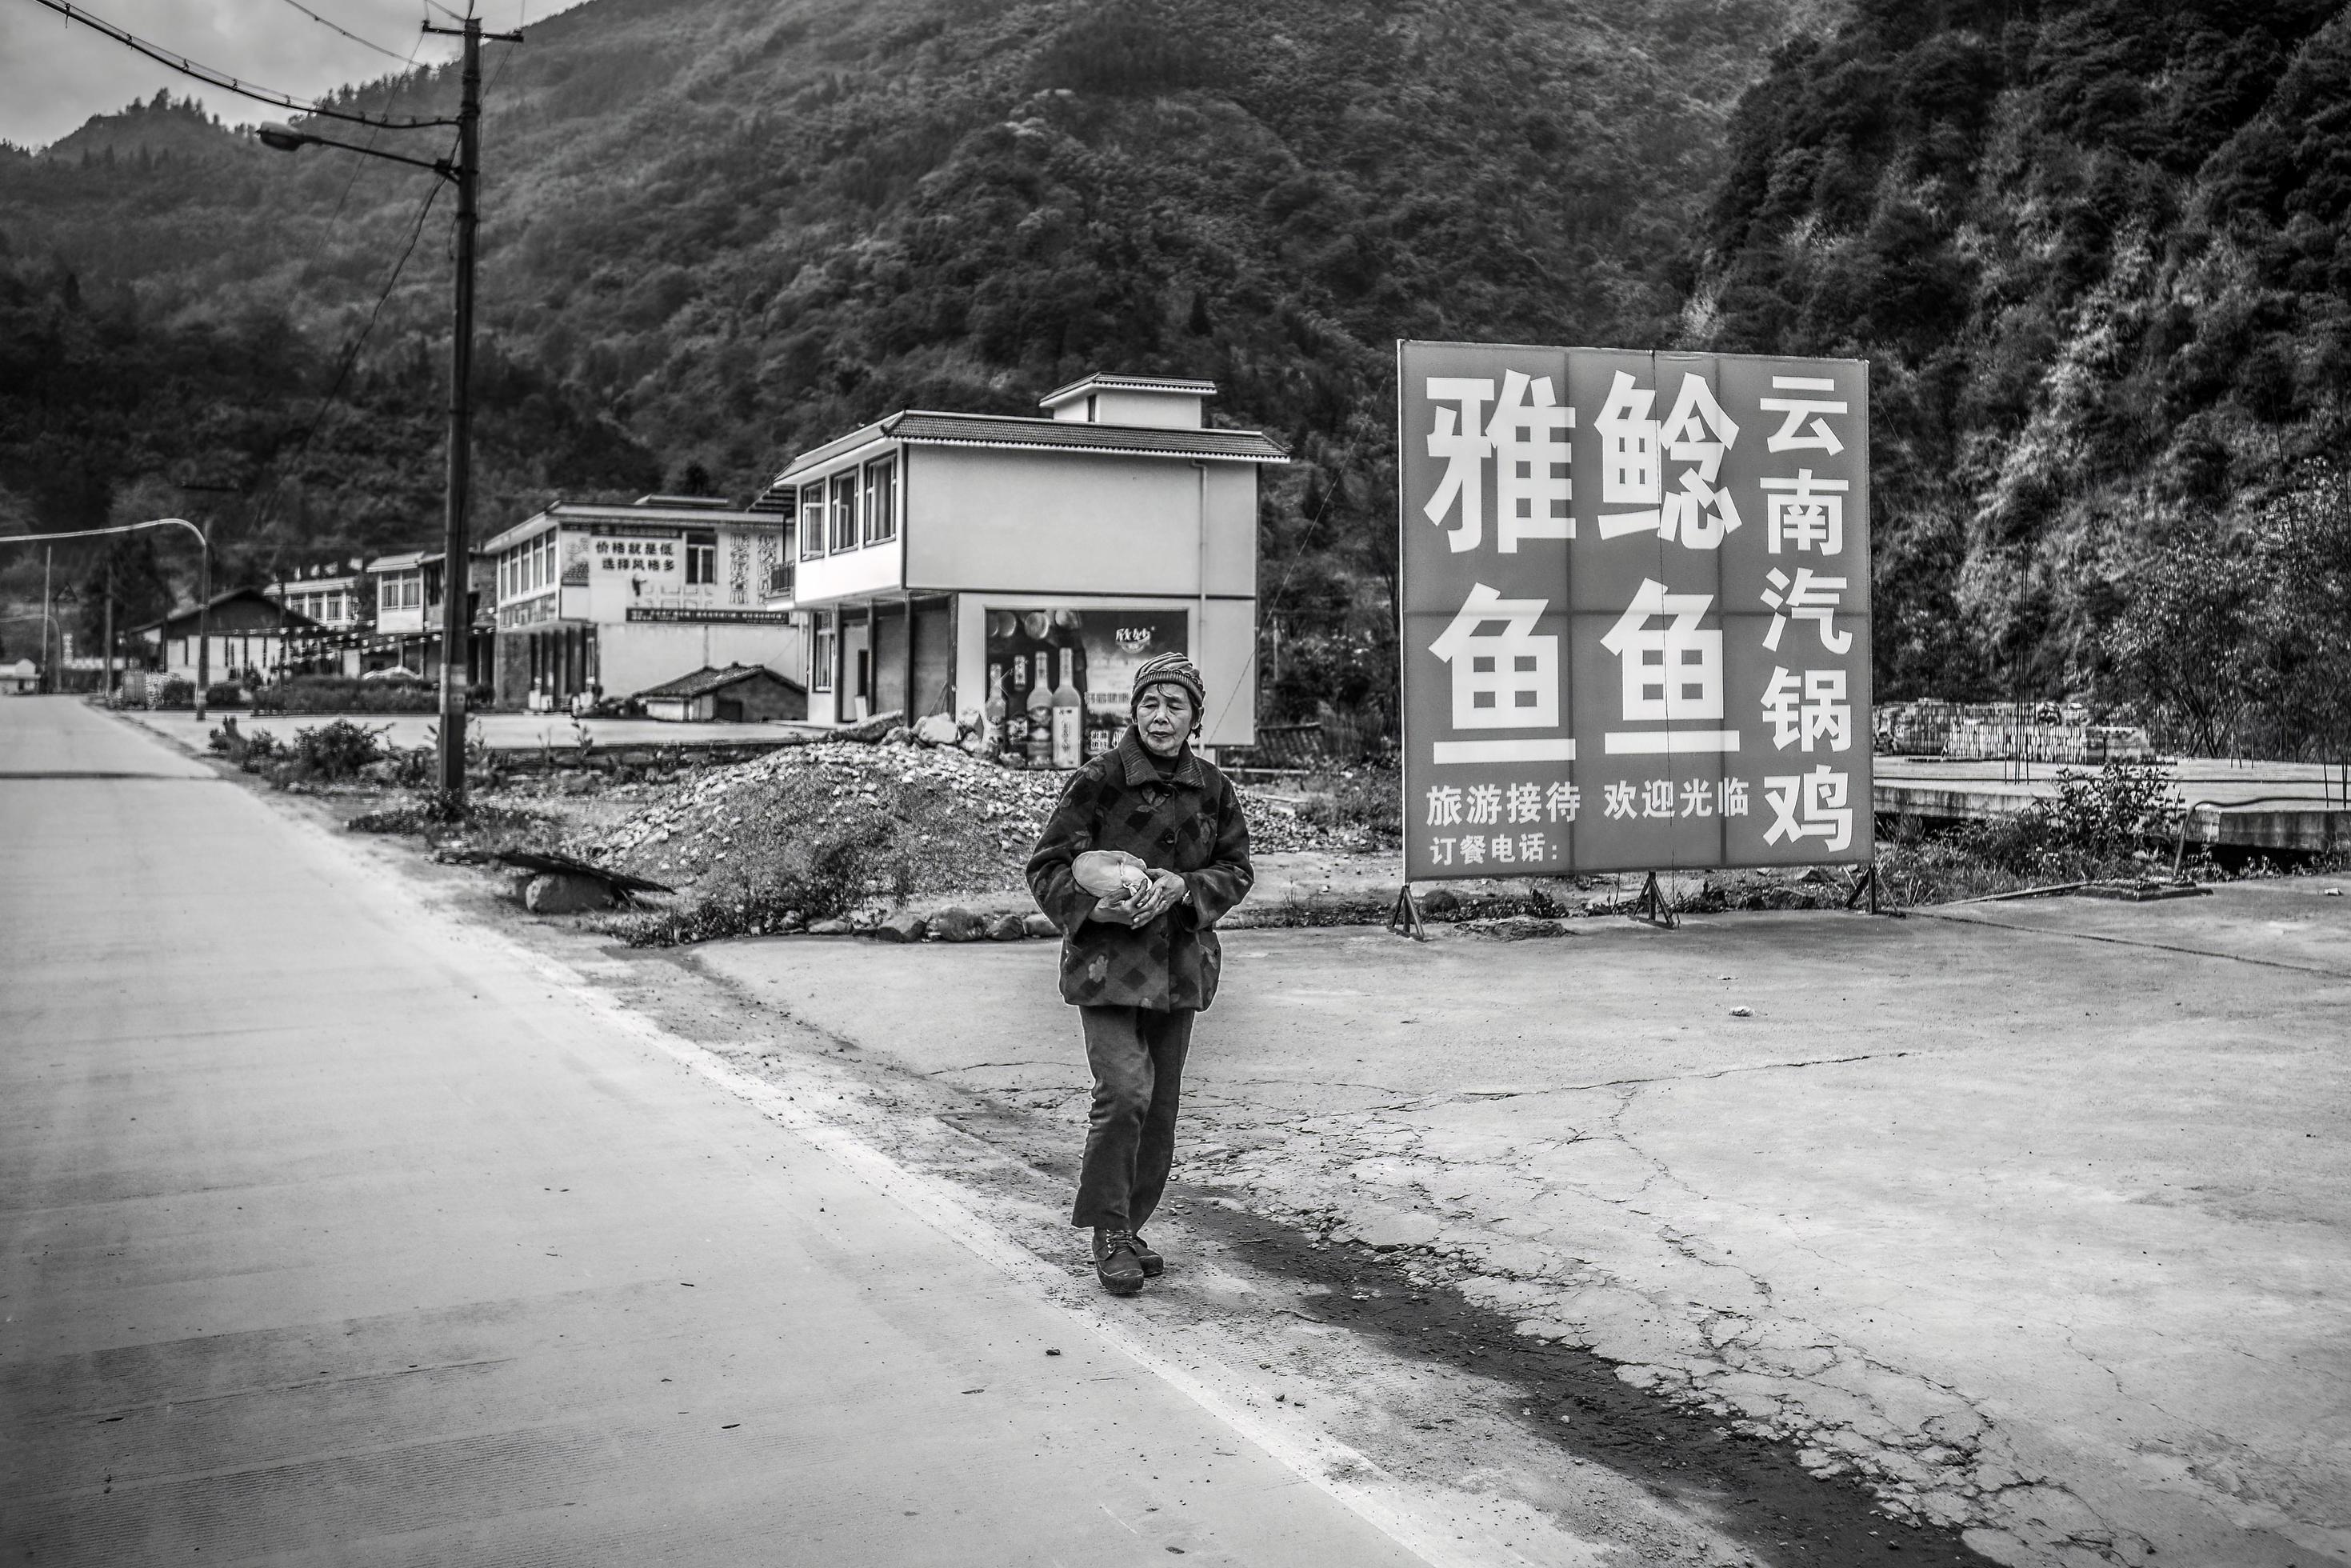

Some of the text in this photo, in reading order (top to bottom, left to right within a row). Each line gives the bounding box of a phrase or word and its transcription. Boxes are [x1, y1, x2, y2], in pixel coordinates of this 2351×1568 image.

[1423, 368, 1577, 765] 雅鱼
[1593, 369, 1742, 755] 鲶鱼
[1759, 374, 1853, 853] 云南汽锅鸡
[1425, 777, 1749, 826] 旅游接待 欢迎光临
[1429, 832, 1557, 866] 订餐电话：
